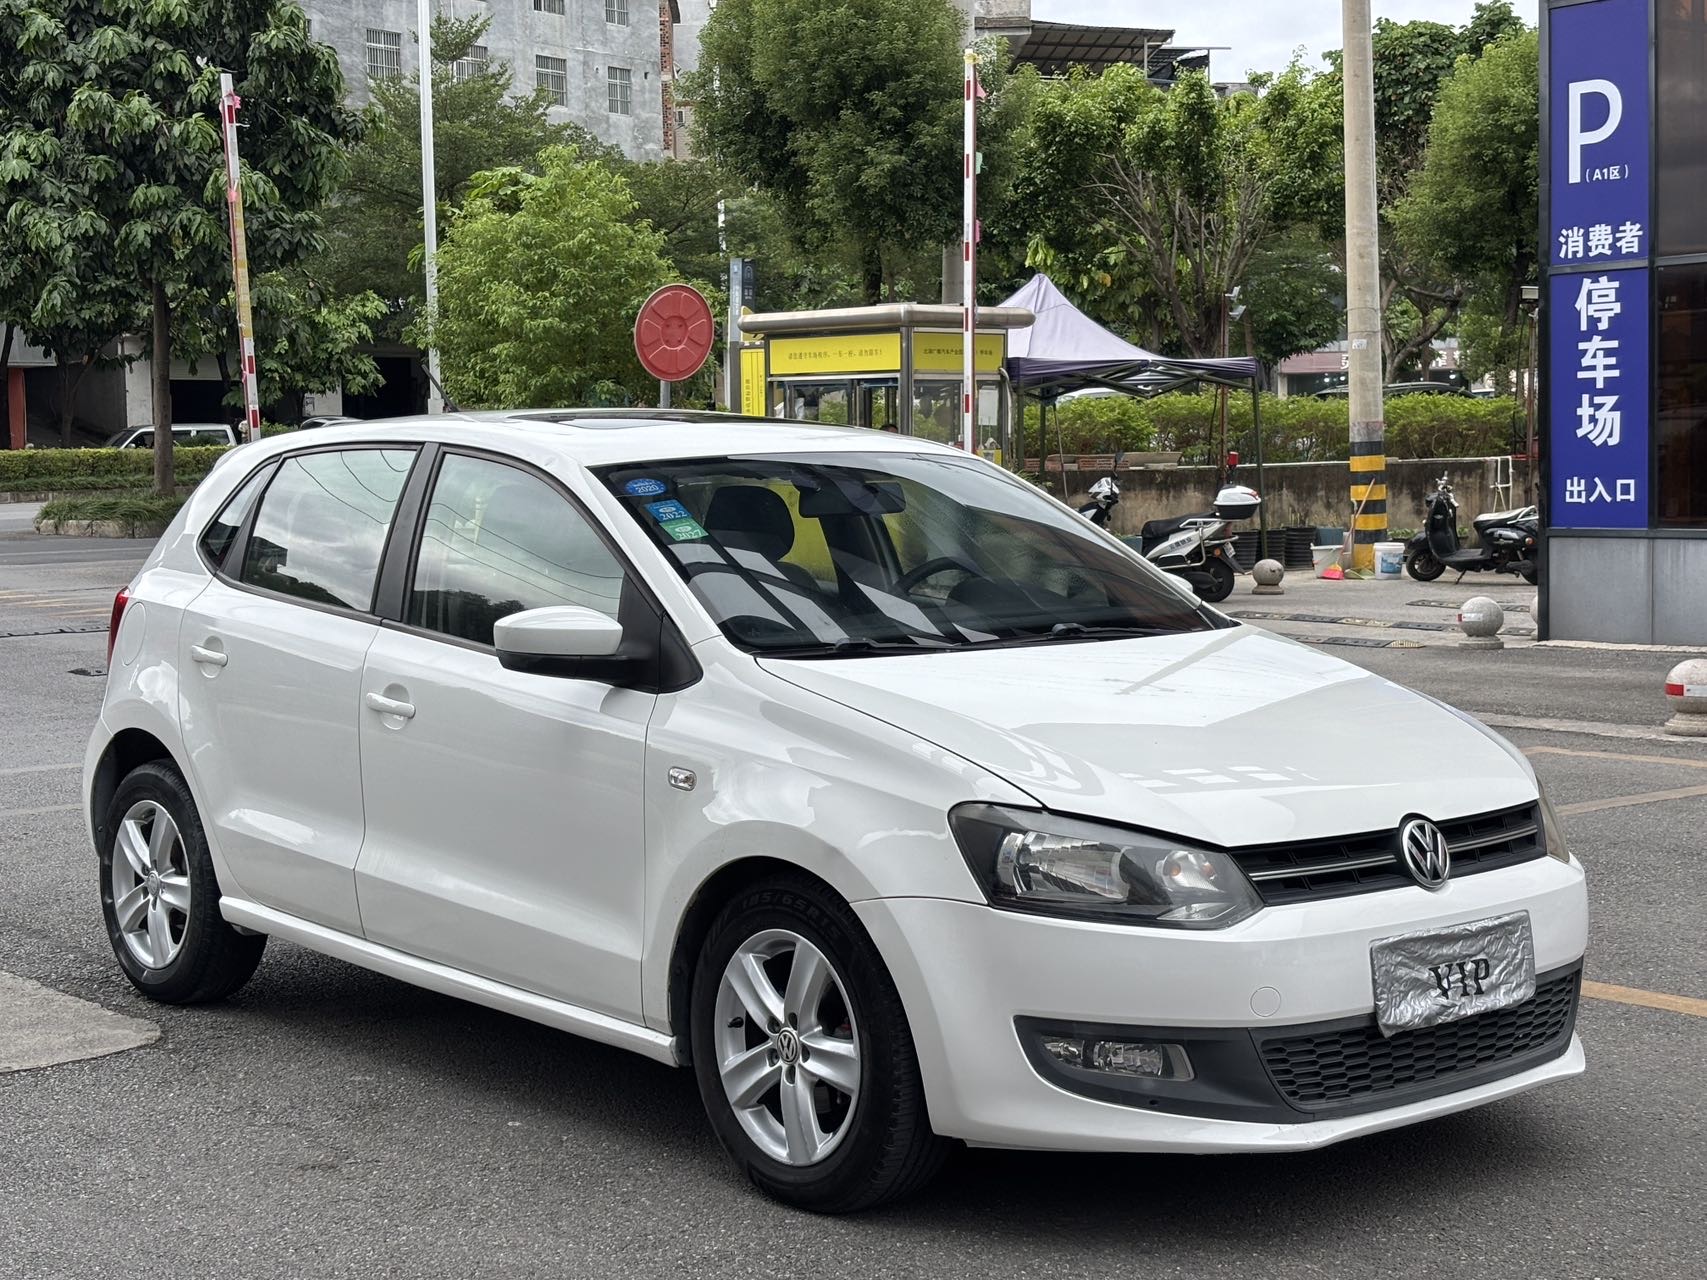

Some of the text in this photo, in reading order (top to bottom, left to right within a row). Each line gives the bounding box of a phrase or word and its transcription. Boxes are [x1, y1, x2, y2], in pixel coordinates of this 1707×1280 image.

[1569, 79, 1622, 184] P
[1558, 221, 1643, 259] 消费者
[1574, 275, 1621, 447] 停车场
[635, 484, 659, 493] 2020
[1565, 476, 1635, 504] 出入口
[660, 510, 688, 521] 2022
[676, 528, 701, 540] 2027
[1428, 958, 1490, 1000] VIP
